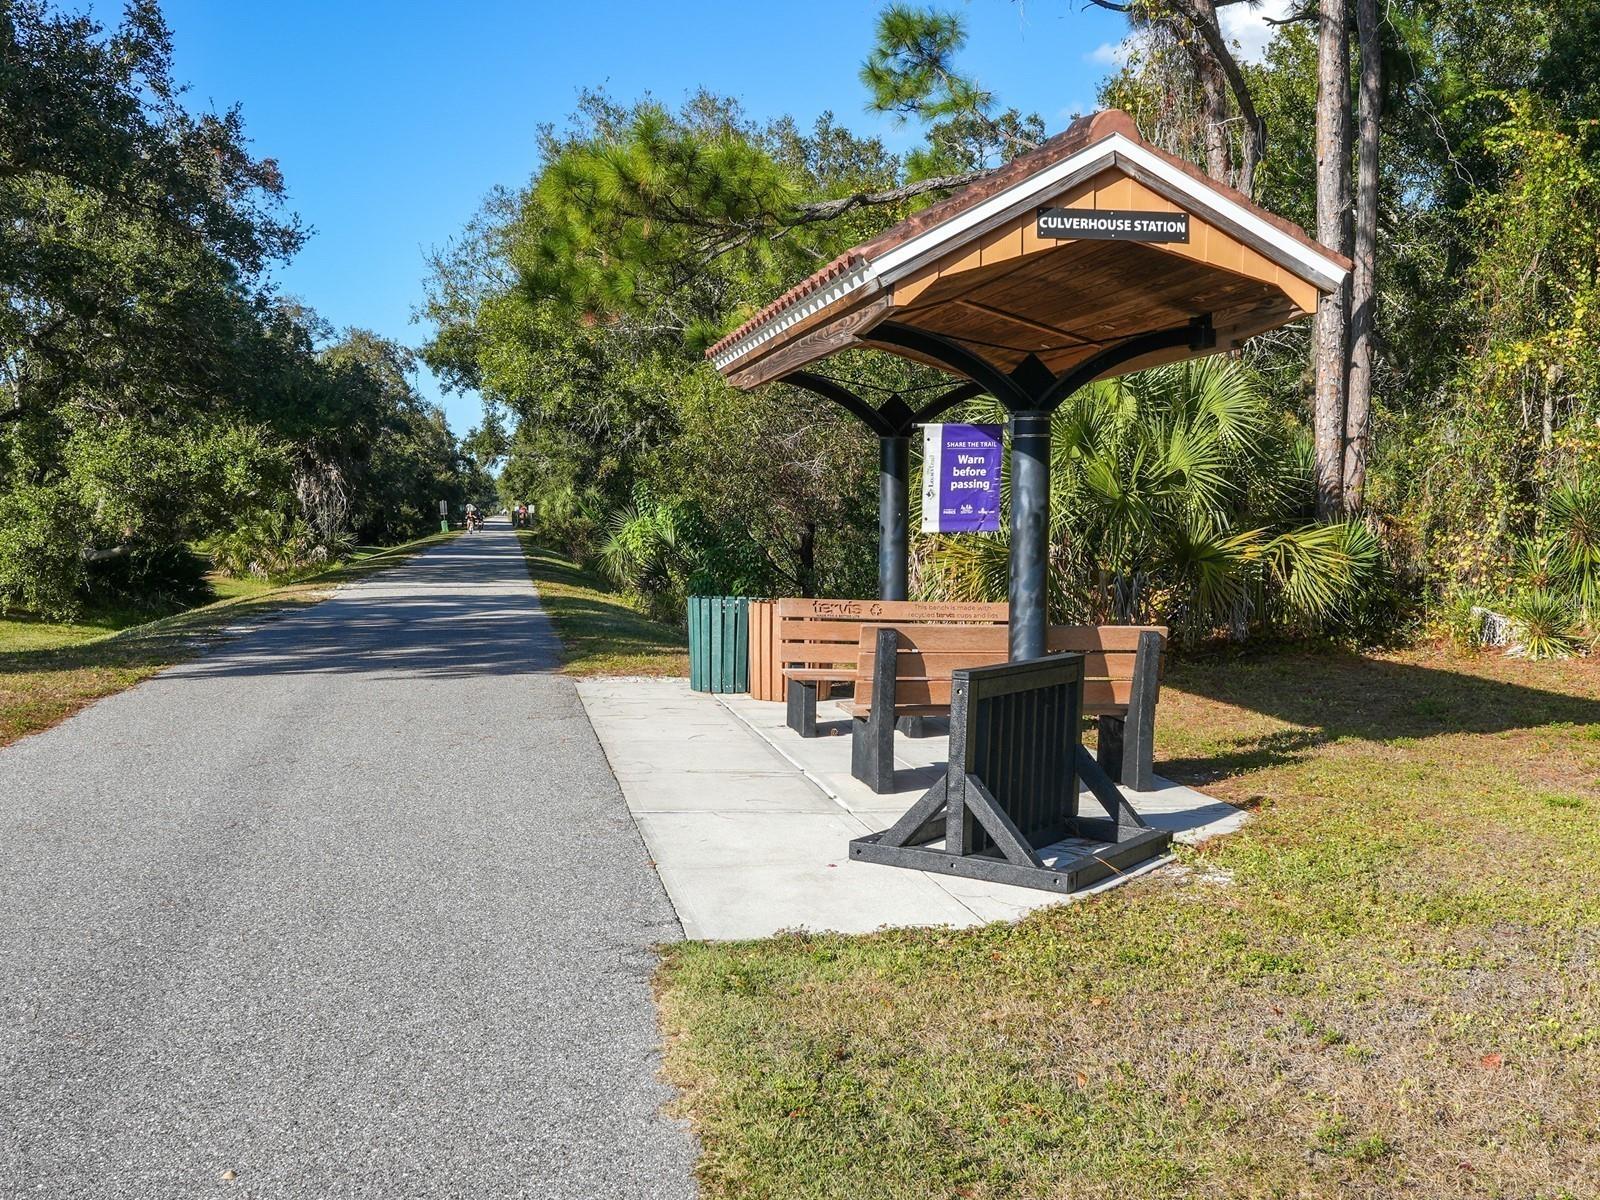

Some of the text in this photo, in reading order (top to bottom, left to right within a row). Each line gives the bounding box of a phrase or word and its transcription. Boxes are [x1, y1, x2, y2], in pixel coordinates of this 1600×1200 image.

[1039, 217, 1186, 233] CULVERHOUSE STATION
[957, 454, 985, 464] Warn
[952, 467, 987, 477] before
[950, 479, 990, 491] passing
